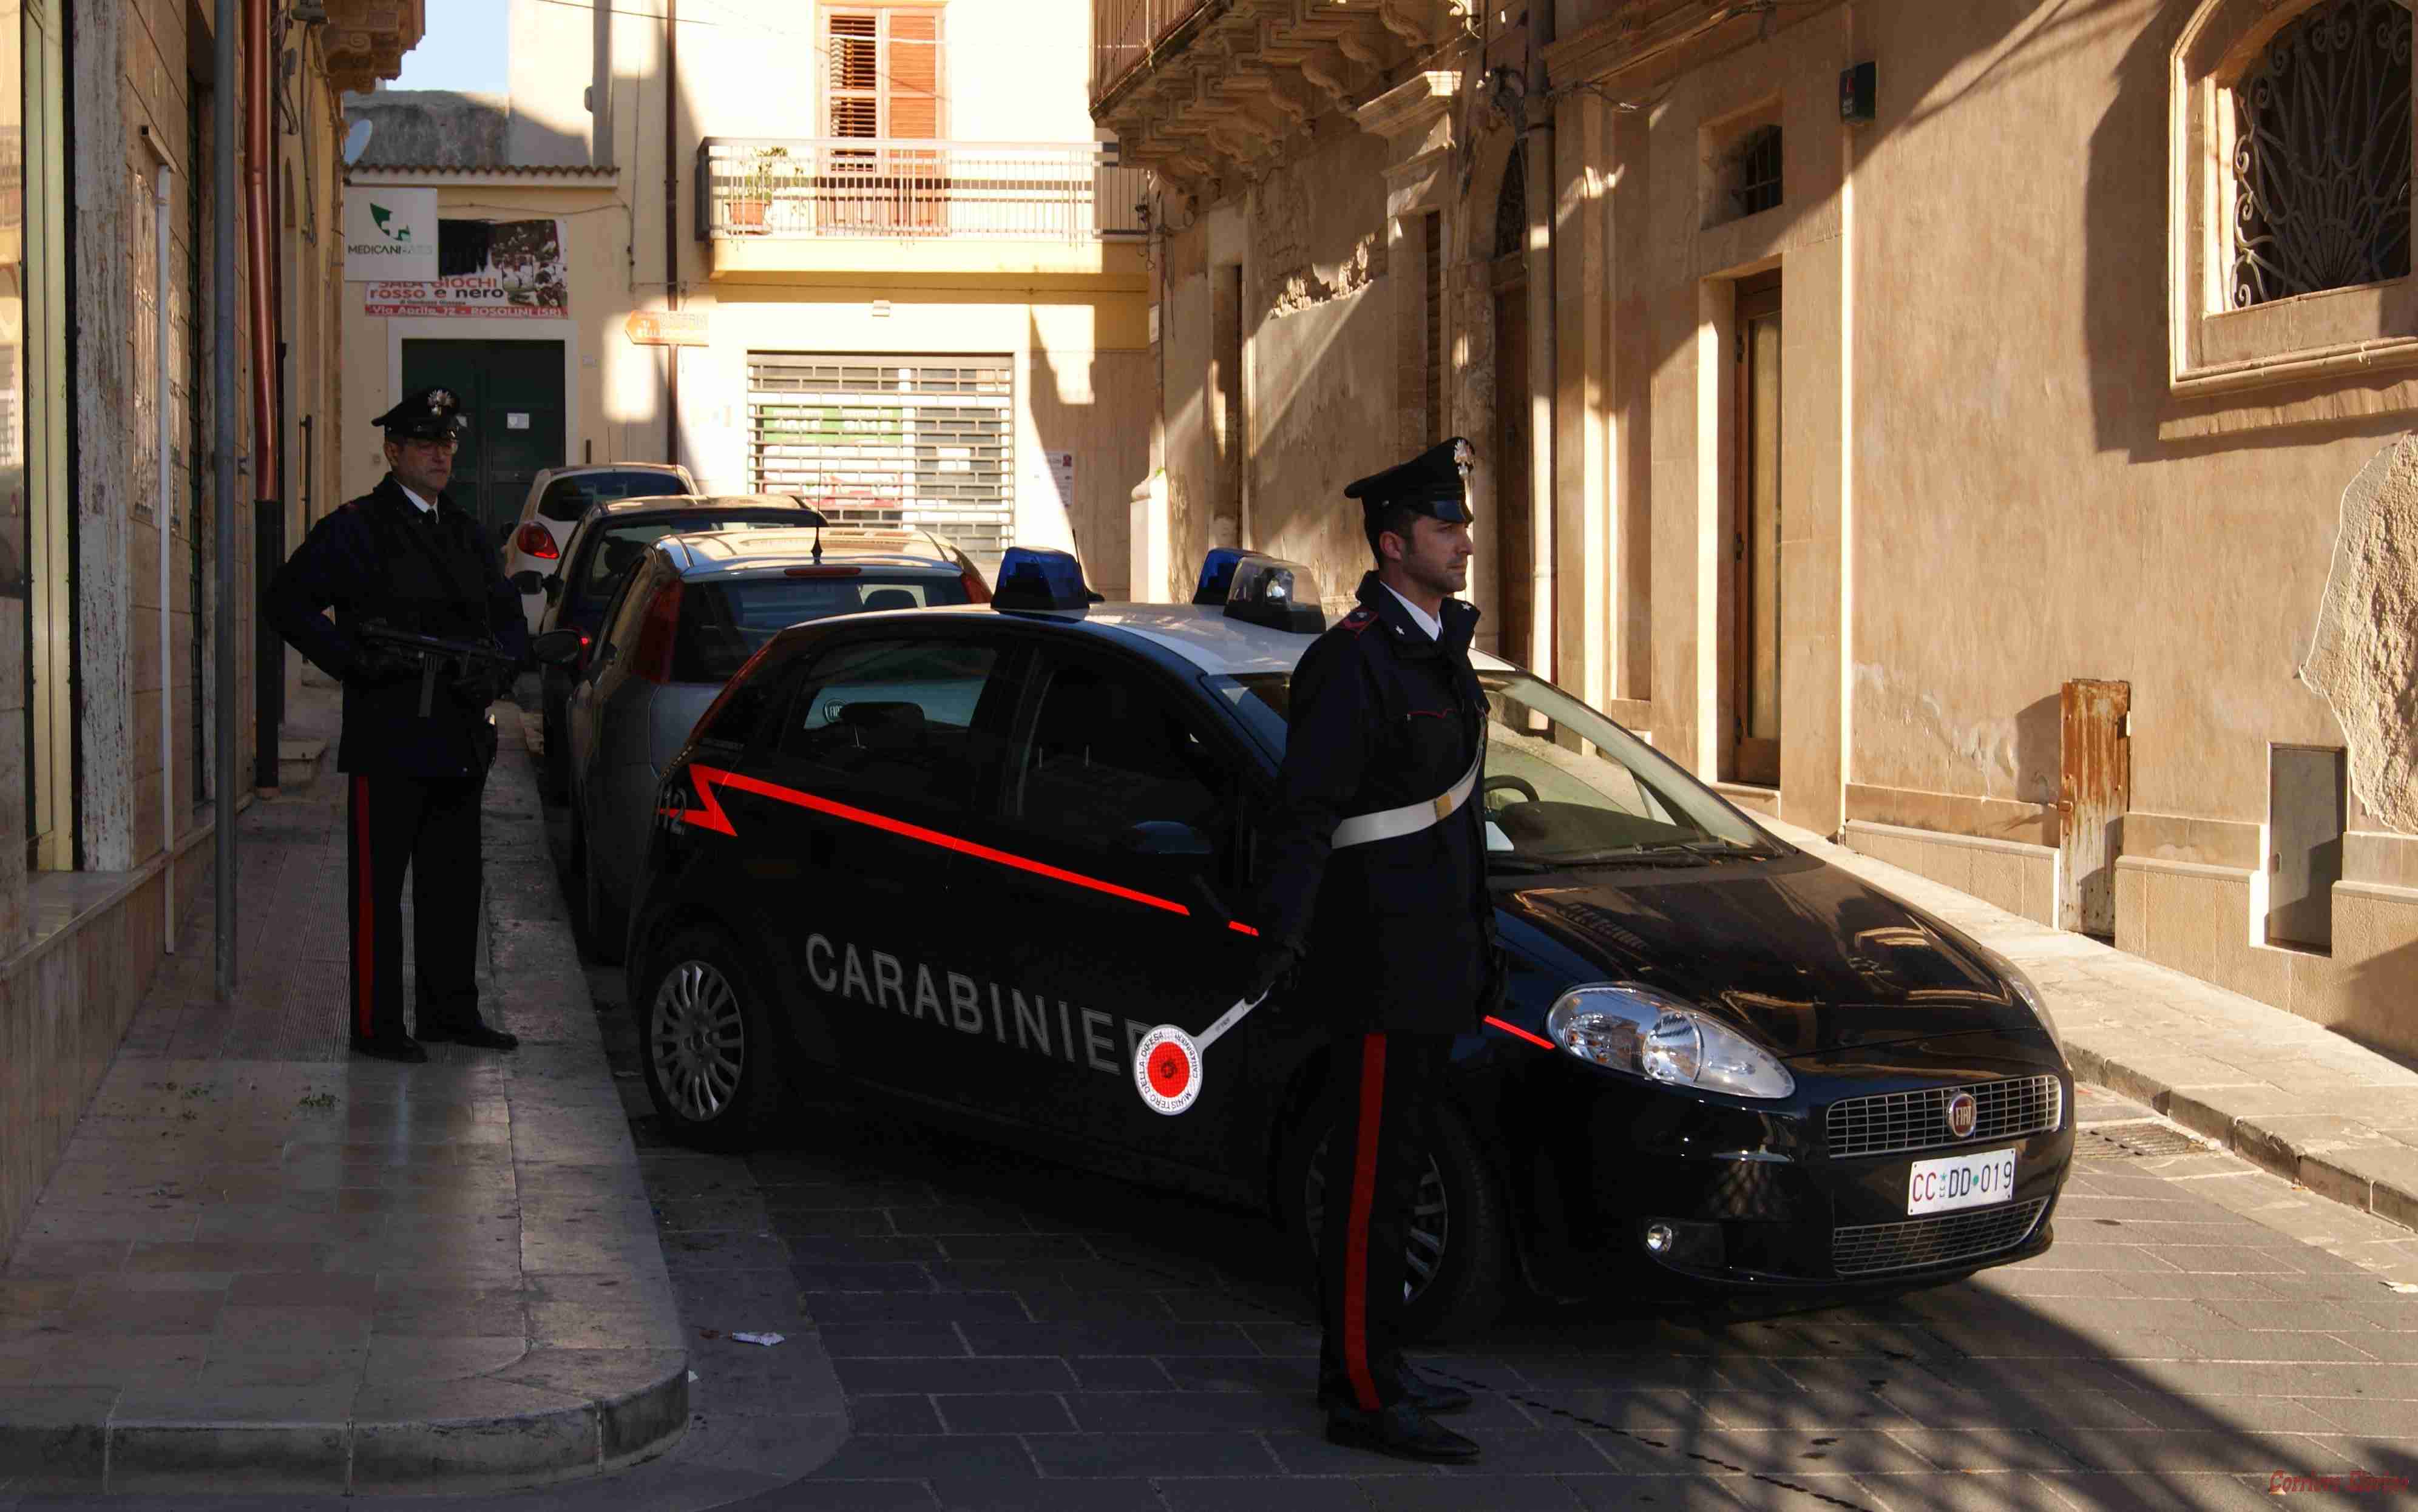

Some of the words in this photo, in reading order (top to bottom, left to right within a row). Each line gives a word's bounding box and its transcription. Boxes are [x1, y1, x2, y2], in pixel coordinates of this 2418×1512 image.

[370, 289, 425, 299] rosso
[434, 289, 447, 298] e
[456, 289, 504, 298] nero
[371, 305, 393, 315] Via
[1956, 1106, 1971, 1126] FIAT
[1912, 1172, 1937, 1202] CC
[1948, 1167, 1971, 1198] DD
[1980, 1161, 2012, 1193] 019
